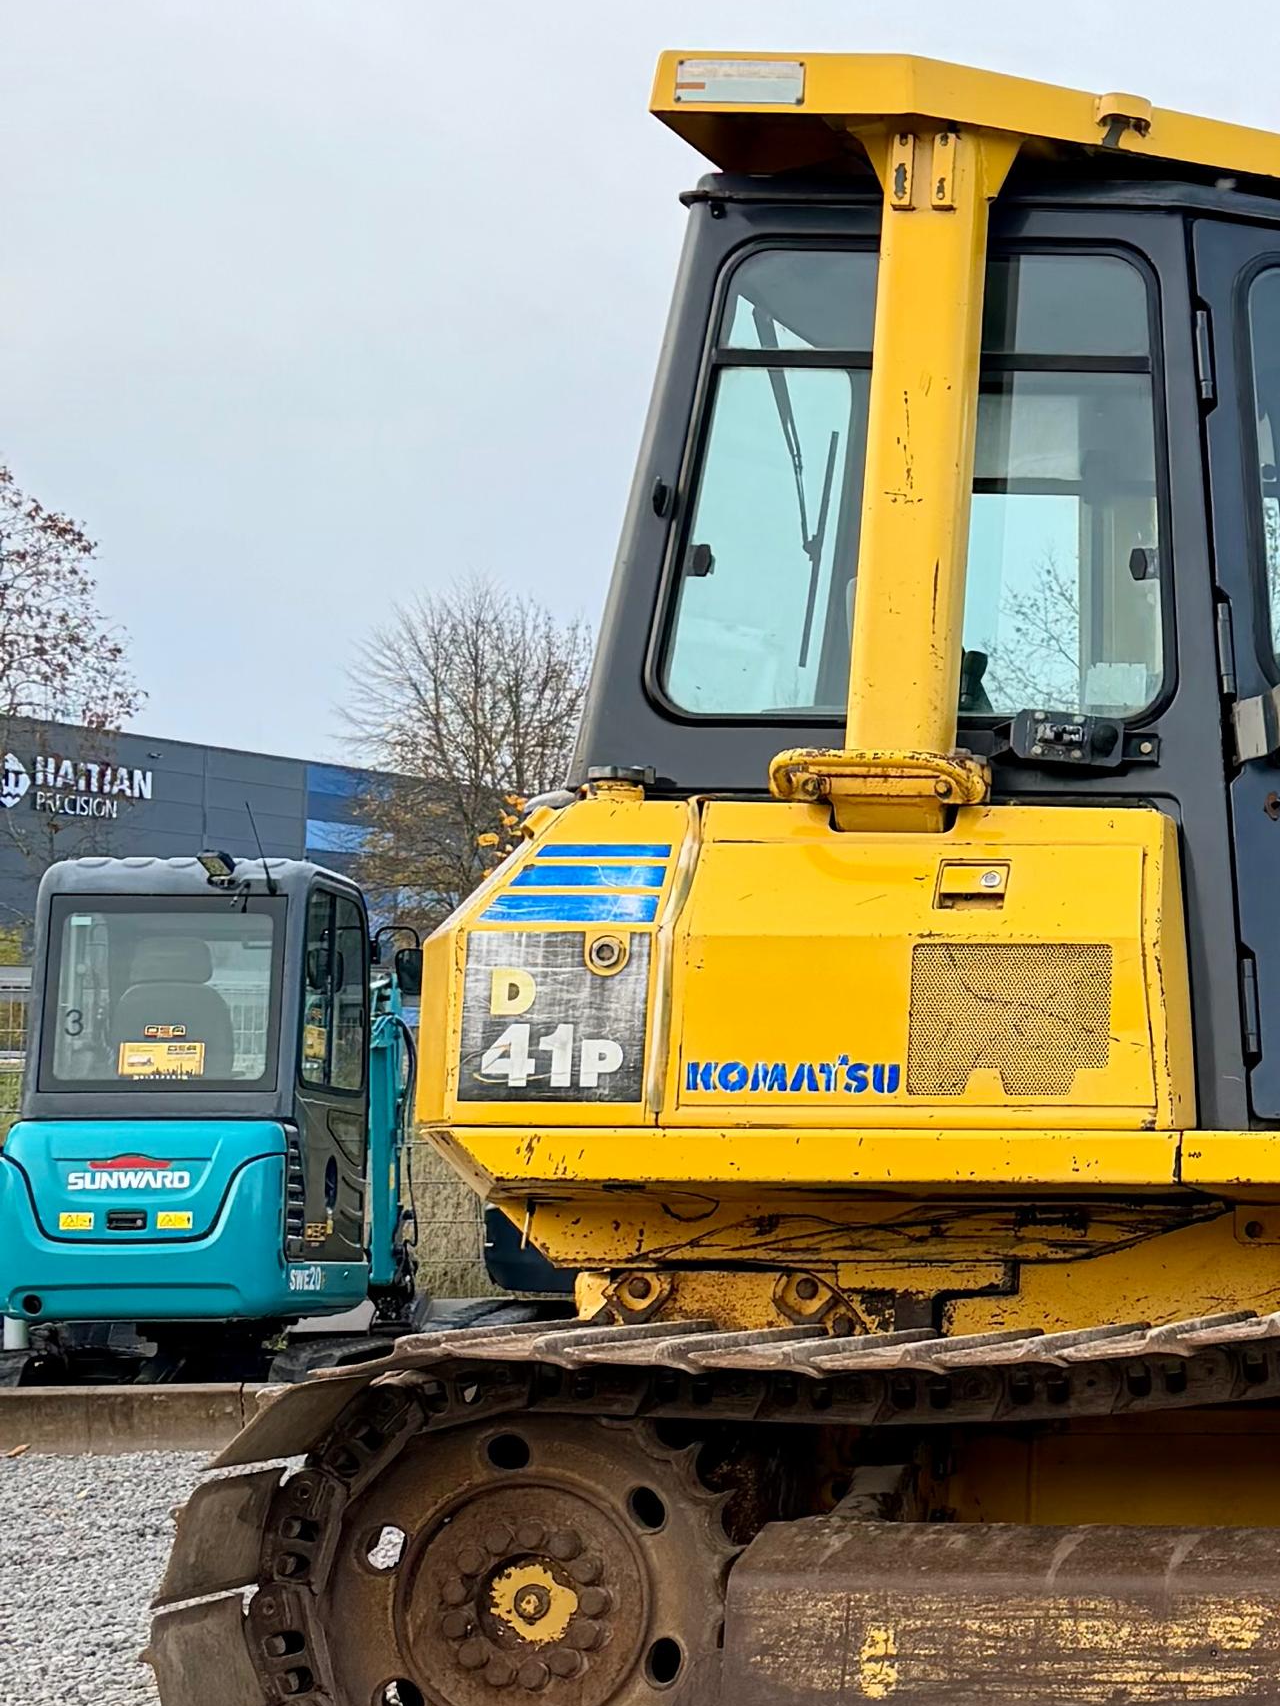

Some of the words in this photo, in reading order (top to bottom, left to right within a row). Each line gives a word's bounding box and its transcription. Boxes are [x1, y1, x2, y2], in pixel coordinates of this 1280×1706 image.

[34, 755, 153, 800] HAITIAN
[36, 791, 118, 819] PRECISION
[490, 968, 537, 1016] D
[64, 1008, 84, 1037] 3
[481, 1023, 624, 1088] 41P
[686, 1053, 901, 1094] KOMATSU
[67, 1170, 191, 1191] SUNWARD
